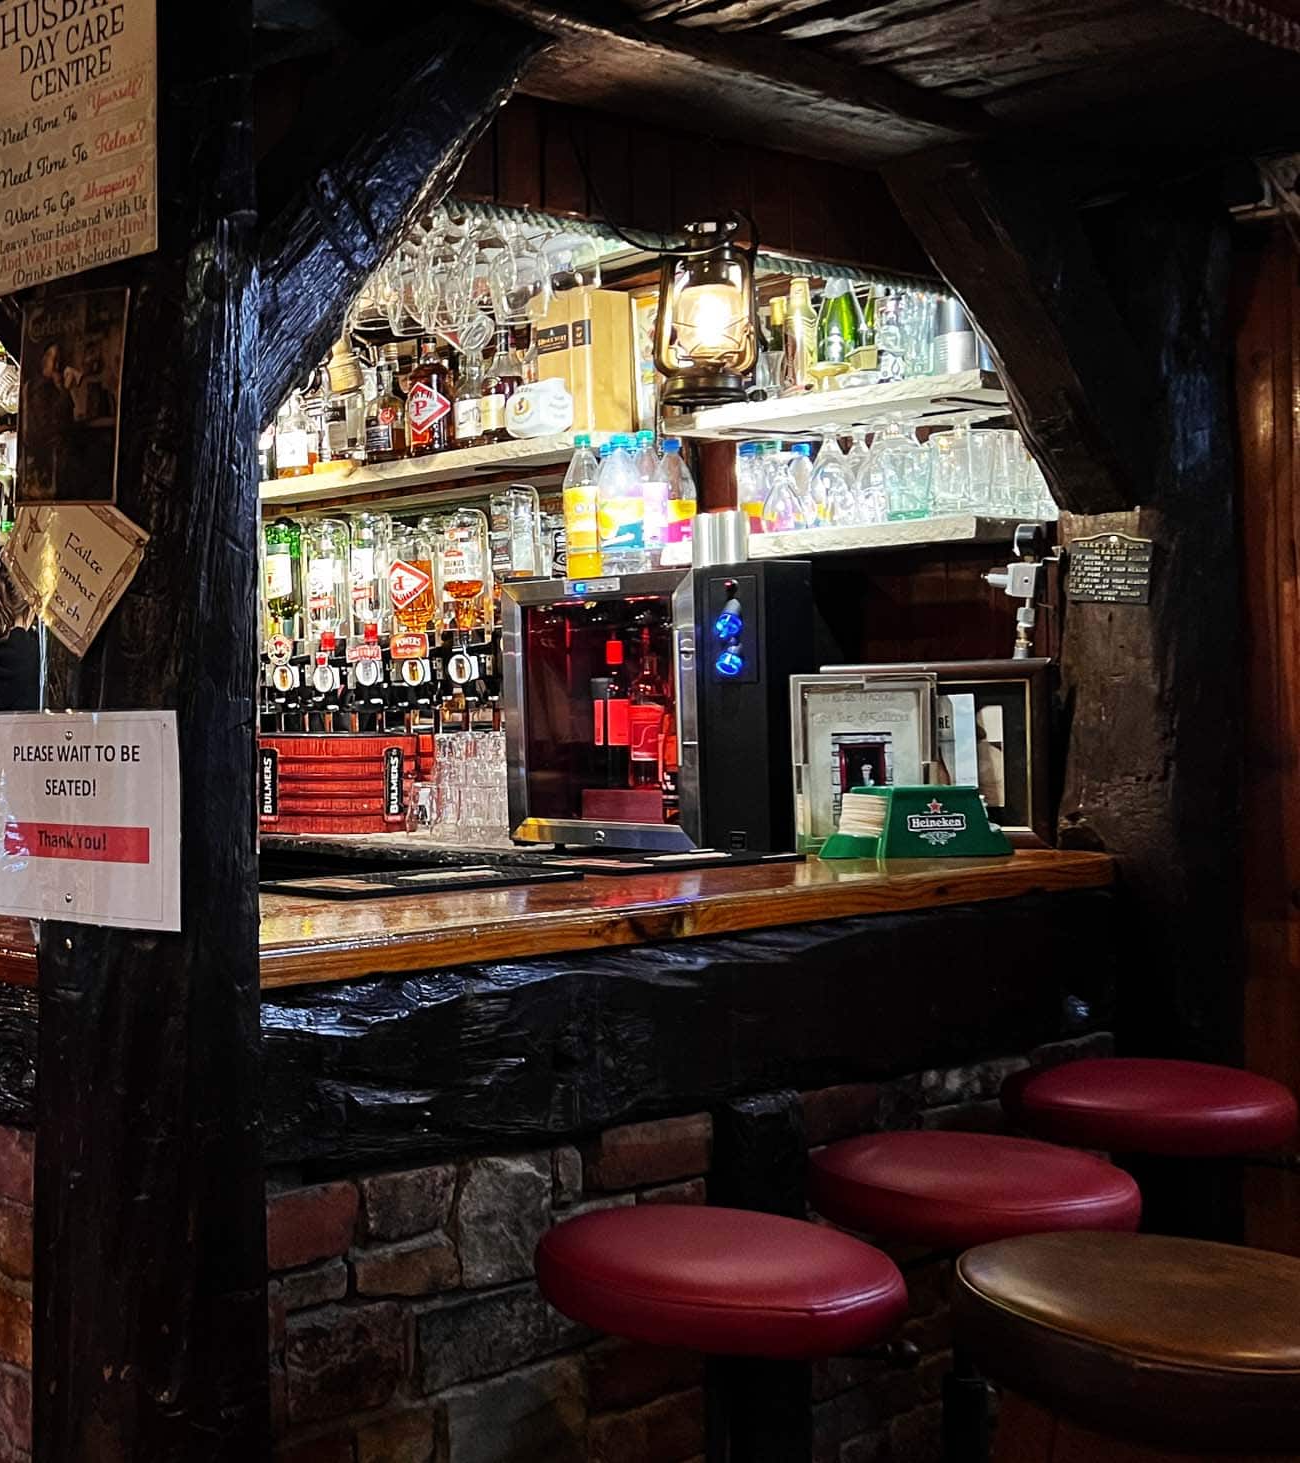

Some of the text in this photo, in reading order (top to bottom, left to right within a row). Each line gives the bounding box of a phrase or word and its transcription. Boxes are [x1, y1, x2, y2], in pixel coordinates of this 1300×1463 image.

[20, 4, 125, 74] DAY CARE
[31, 45, 112, 102] CENTRE
[33, 116, 60, 135] Time
[63, 104, 78, 124] To
[37, 155, 68, 177] Time
[72, 142, 88, 165] To
[95, 119, 146, 154] Relax?
[4, 164, 145, 226] Want To Go Shopping?
[0, 194, 148, 256] Leave Your Husband With Us
[0, 254, 22, 273] And
[84, 227, 113, 248] After
[12, 264, 53, 287] (Drinks
[77, 238, 131, 268] Included)
[13, 745, 141, 762] PLEASE WAIT TO BE
[45, 779, 96, 797] SEATED!
[263, 756, 273, 814] BULMERS
[390, 756, 400, 814] BULMERS
[38, 830, 107, 851] Thank You!
[911, 817, 963, 829] Heineken
